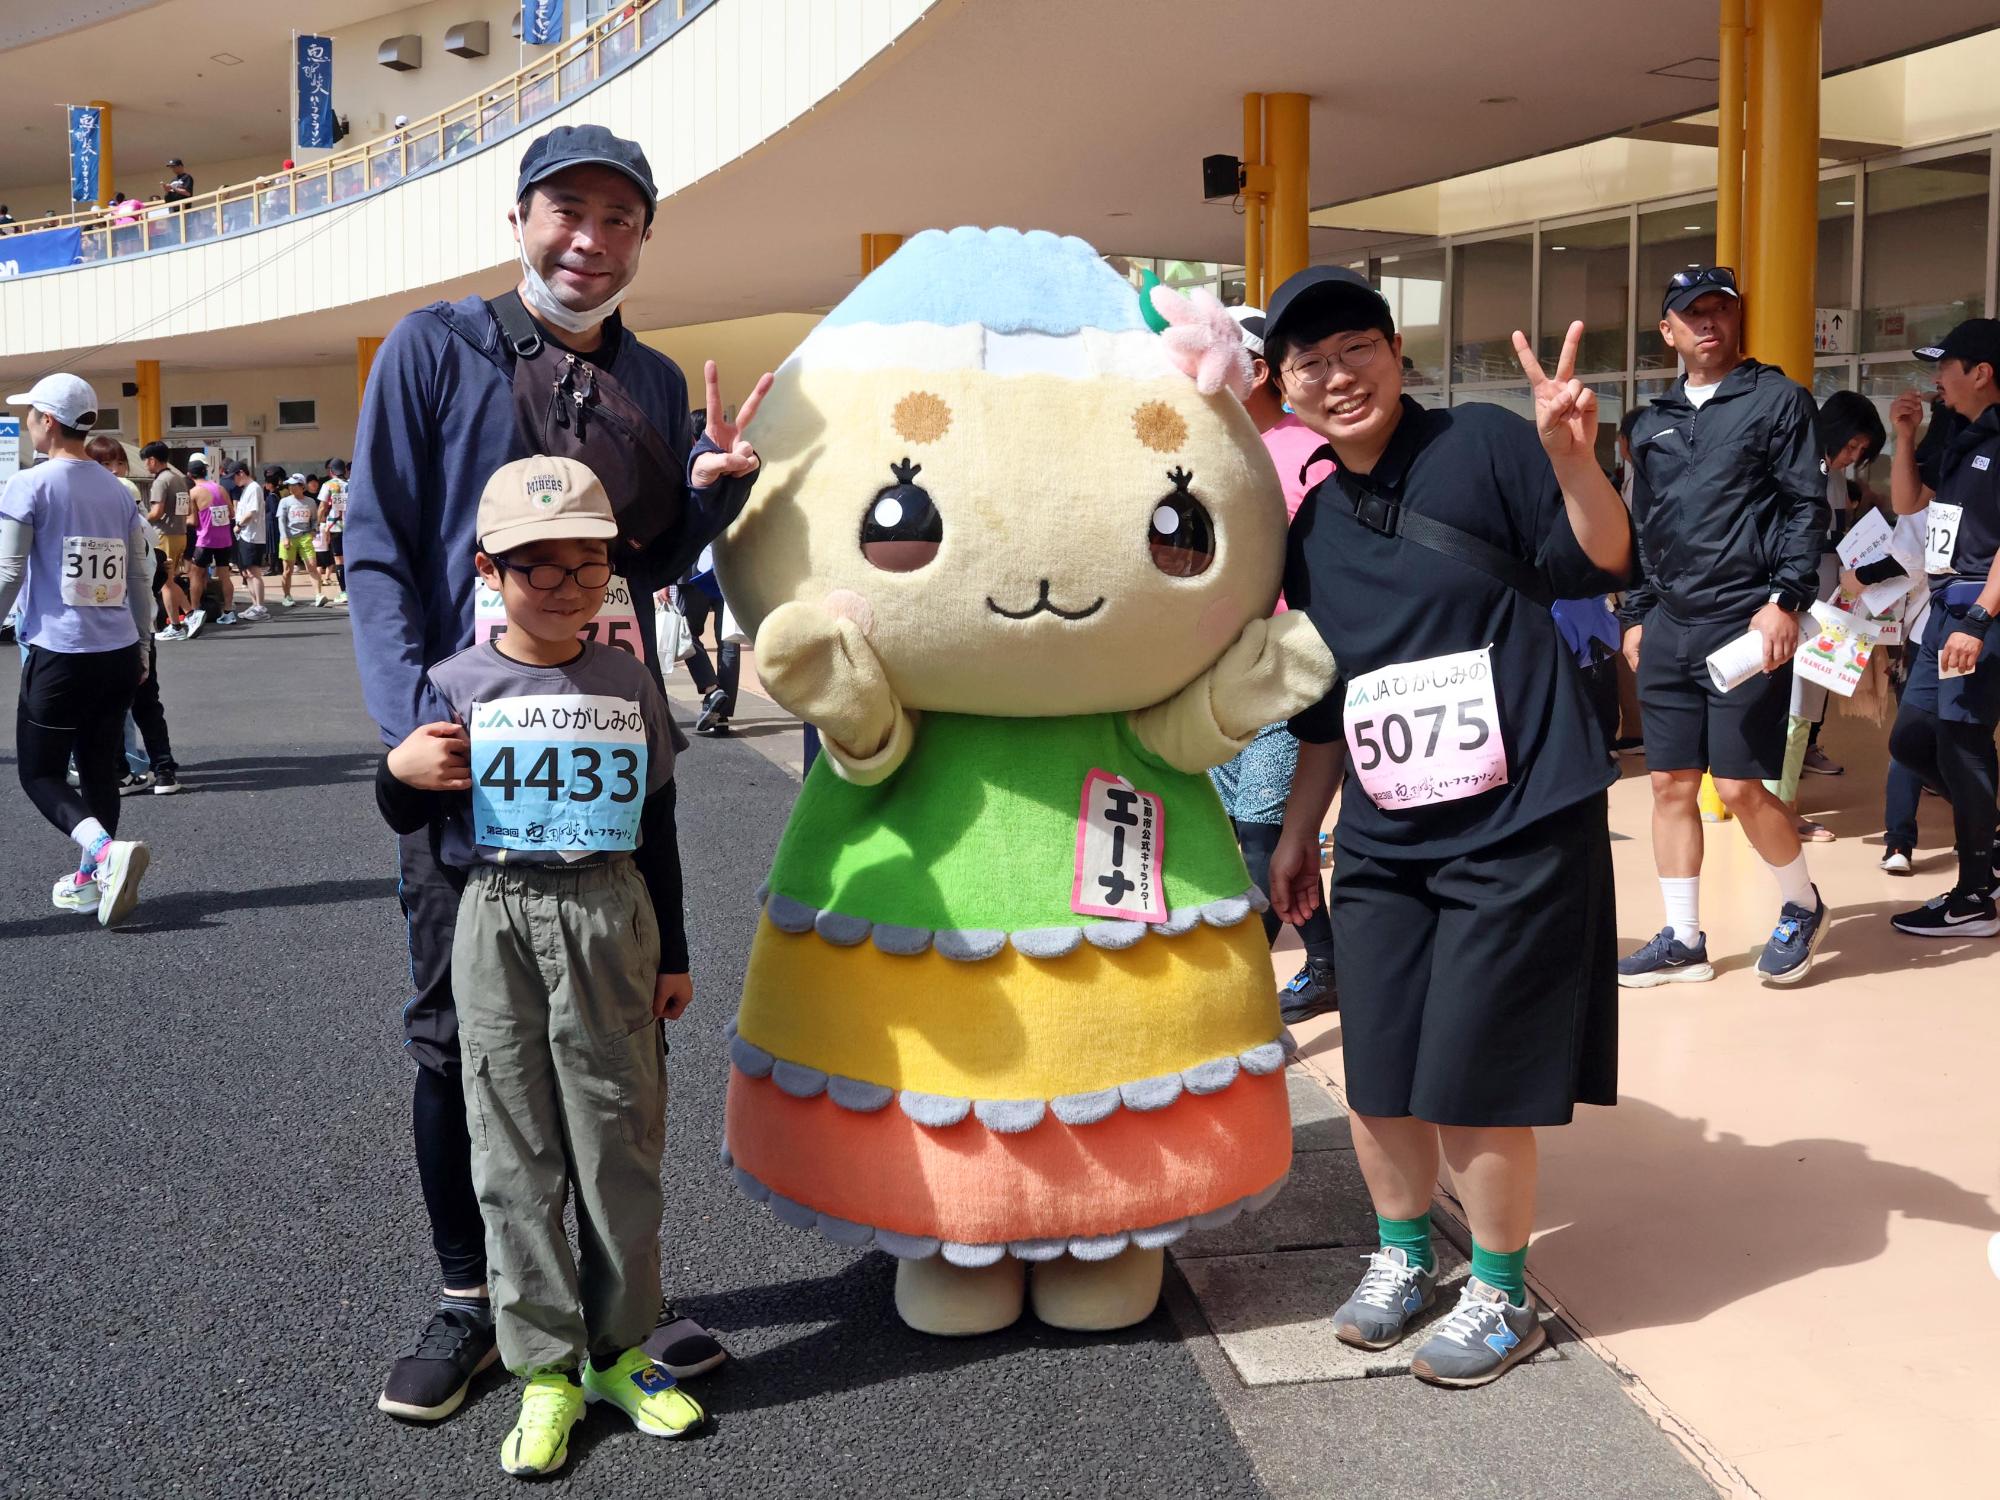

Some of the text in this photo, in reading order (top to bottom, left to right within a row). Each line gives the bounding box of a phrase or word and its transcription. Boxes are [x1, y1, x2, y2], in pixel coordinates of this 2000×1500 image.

[527, 480, 562, 495] MINERS
[66, 553, 123, 580] 3161
[1354, 697, 1490, 771] 5075
[480, 746, 640, 803] 4433
[1098, 788, 1139, 905] エーナ
